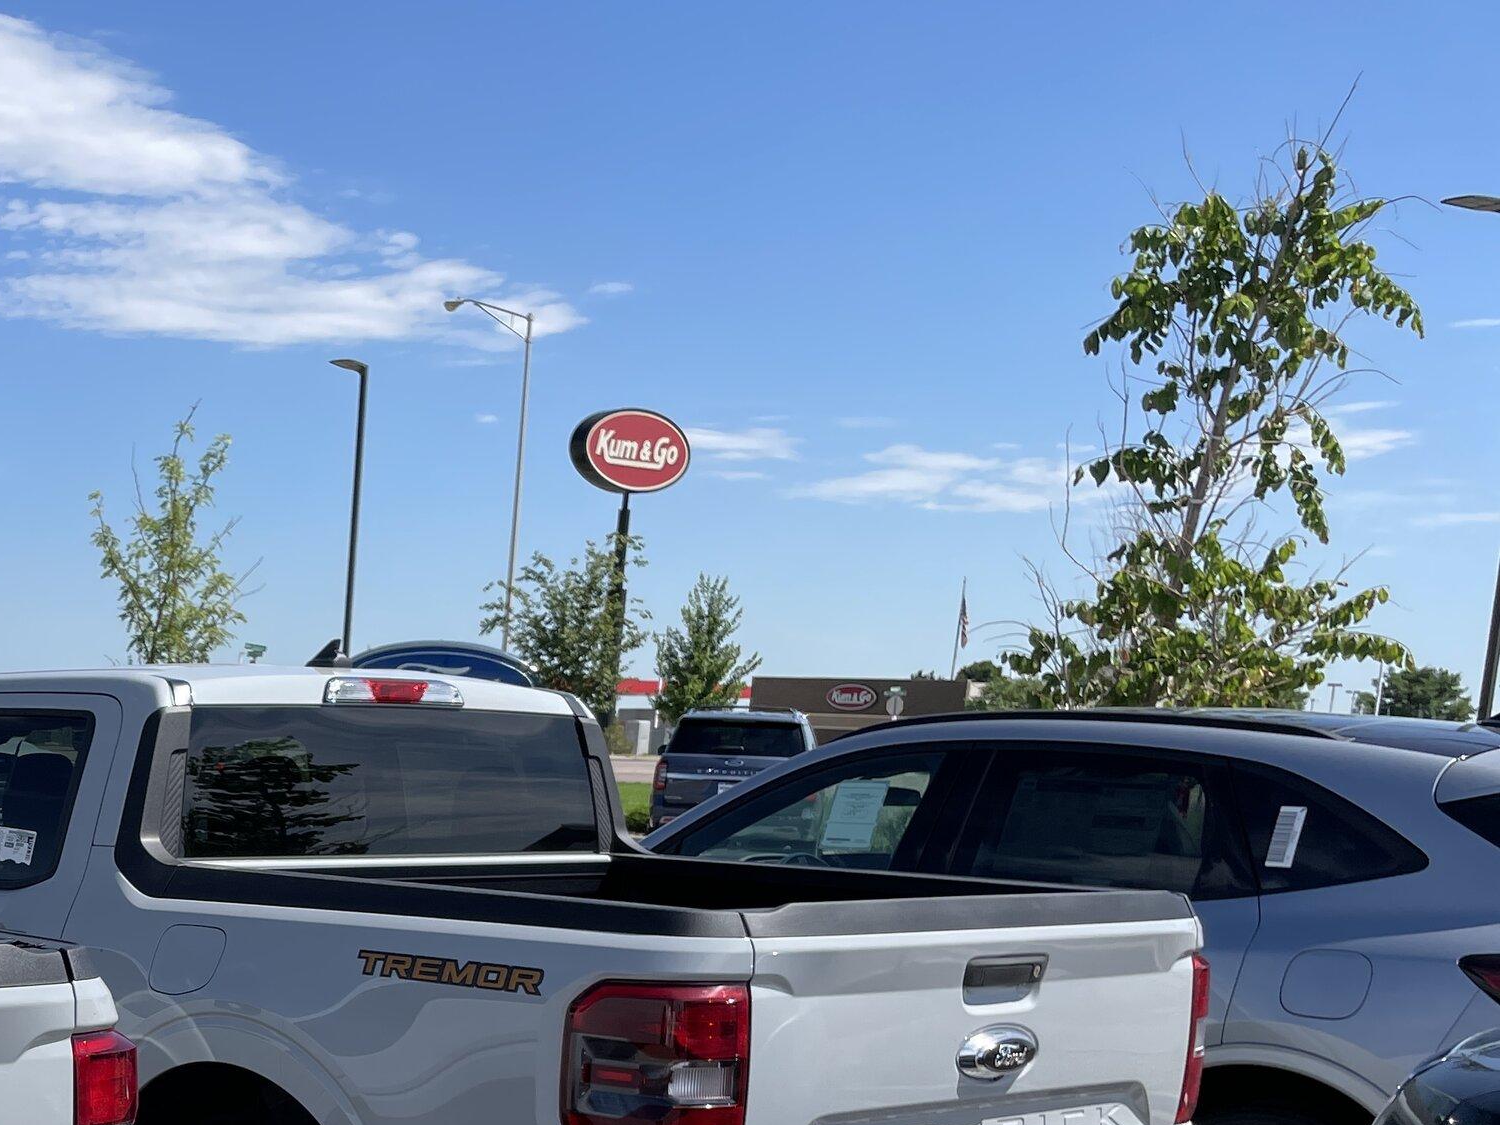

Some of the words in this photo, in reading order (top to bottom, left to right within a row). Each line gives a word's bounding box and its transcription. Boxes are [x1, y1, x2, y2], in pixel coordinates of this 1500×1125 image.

[595, 428, 639, 460] Kum
[639, 440, 652, 461] &
[653, 437, 679, 466] Go
[358, 949, 545, 996] TREMOR
[994, 1043, 1029, 1068] Ford
